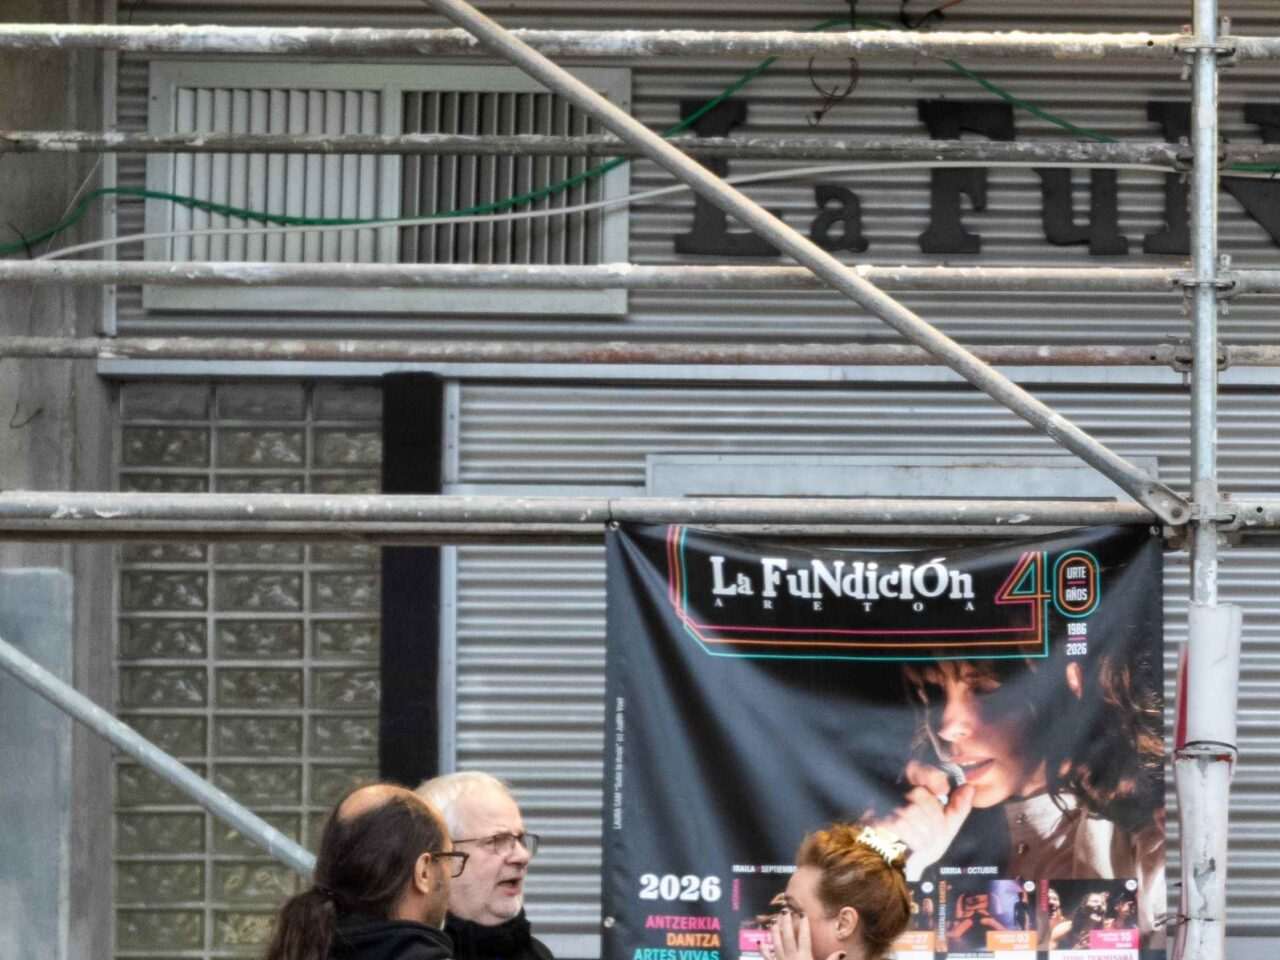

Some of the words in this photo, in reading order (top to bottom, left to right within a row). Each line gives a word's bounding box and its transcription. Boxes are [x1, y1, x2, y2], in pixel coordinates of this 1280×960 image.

[675, 98, 870, 256] La
[709, 555, 755, 596] La
[1066, 566, 1088, 580] URTE
[1067, 622, 1088, 636] 1986
[1066, 642, 1088, 656] 2026
[967, 866, 998, 874] OCTUBRE
[639, 873, 722, 902] 2026
[645, 915, 721, 930] ANTZERKIA
[666, 932, 721, 948] DANTZA
